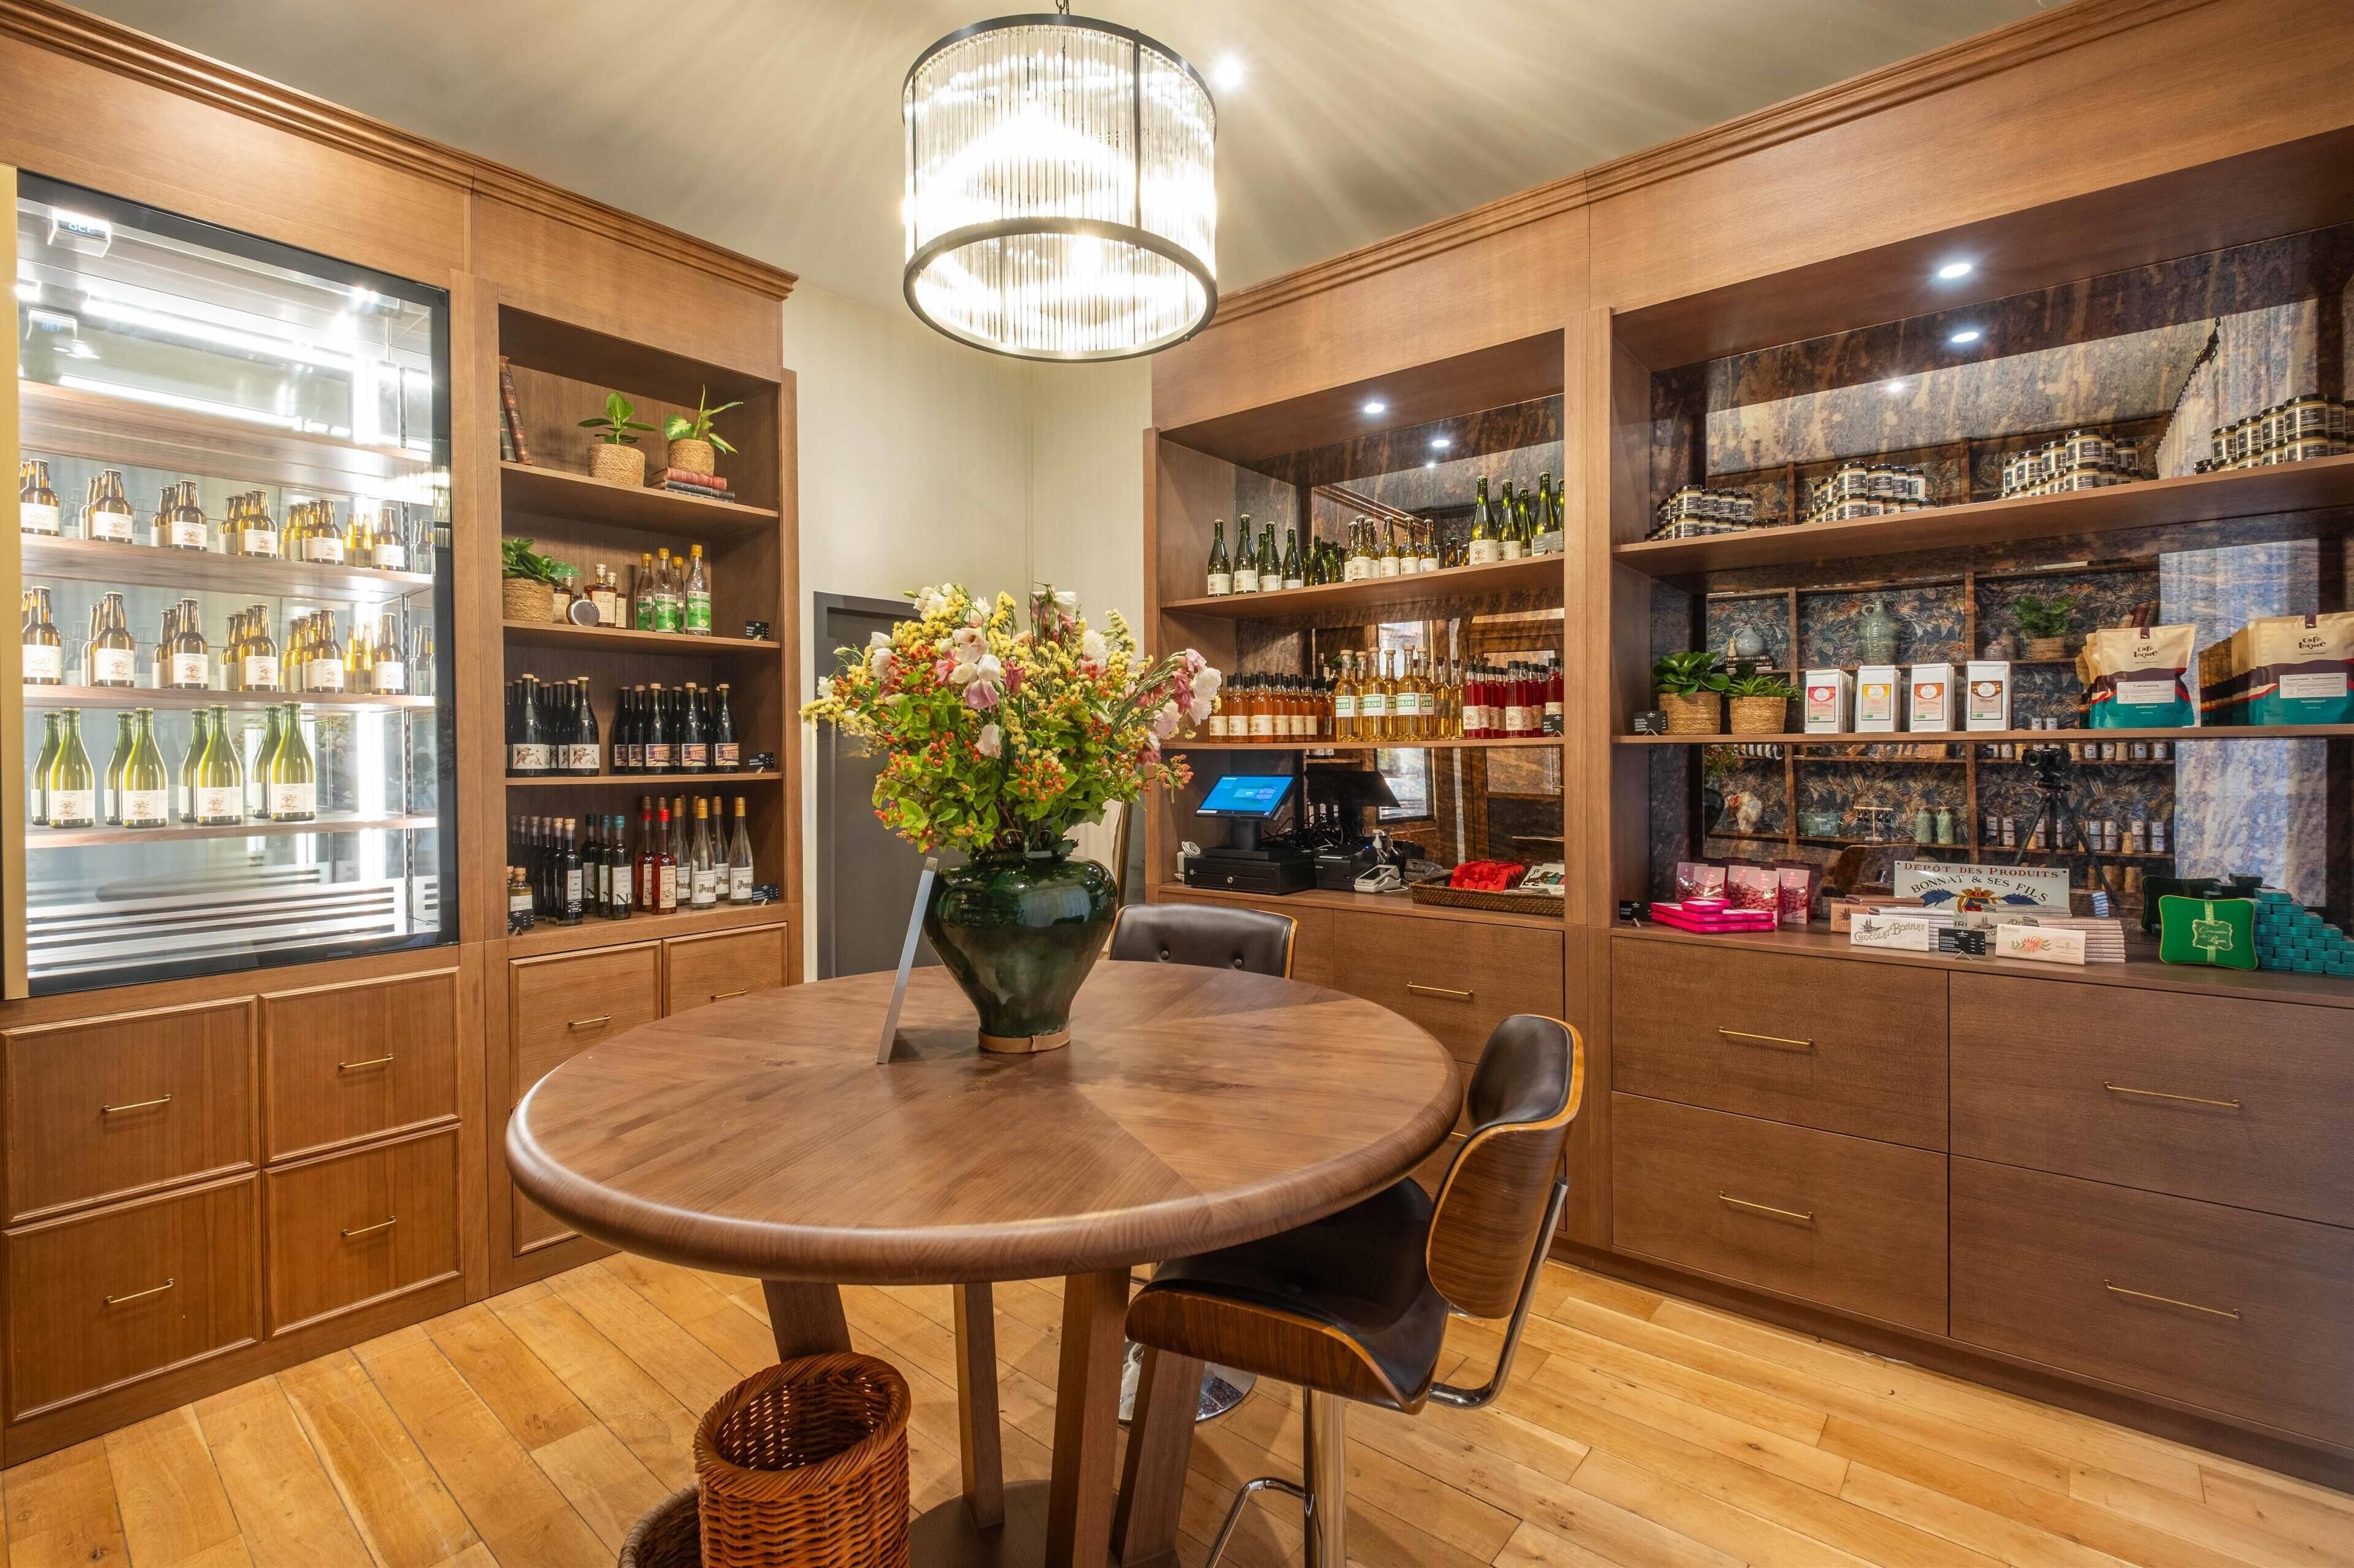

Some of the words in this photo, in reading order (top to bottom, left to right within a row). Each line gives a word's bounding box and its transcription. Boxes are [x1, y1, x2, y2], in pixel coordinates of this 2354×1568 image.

[1990, 867, 2059, 878] PRODUITS
[1910, 875, 1964, 894] BONNAT
[1987, 877, 2010, 887] SES
[2016, 883, 2048, 902] FILS
